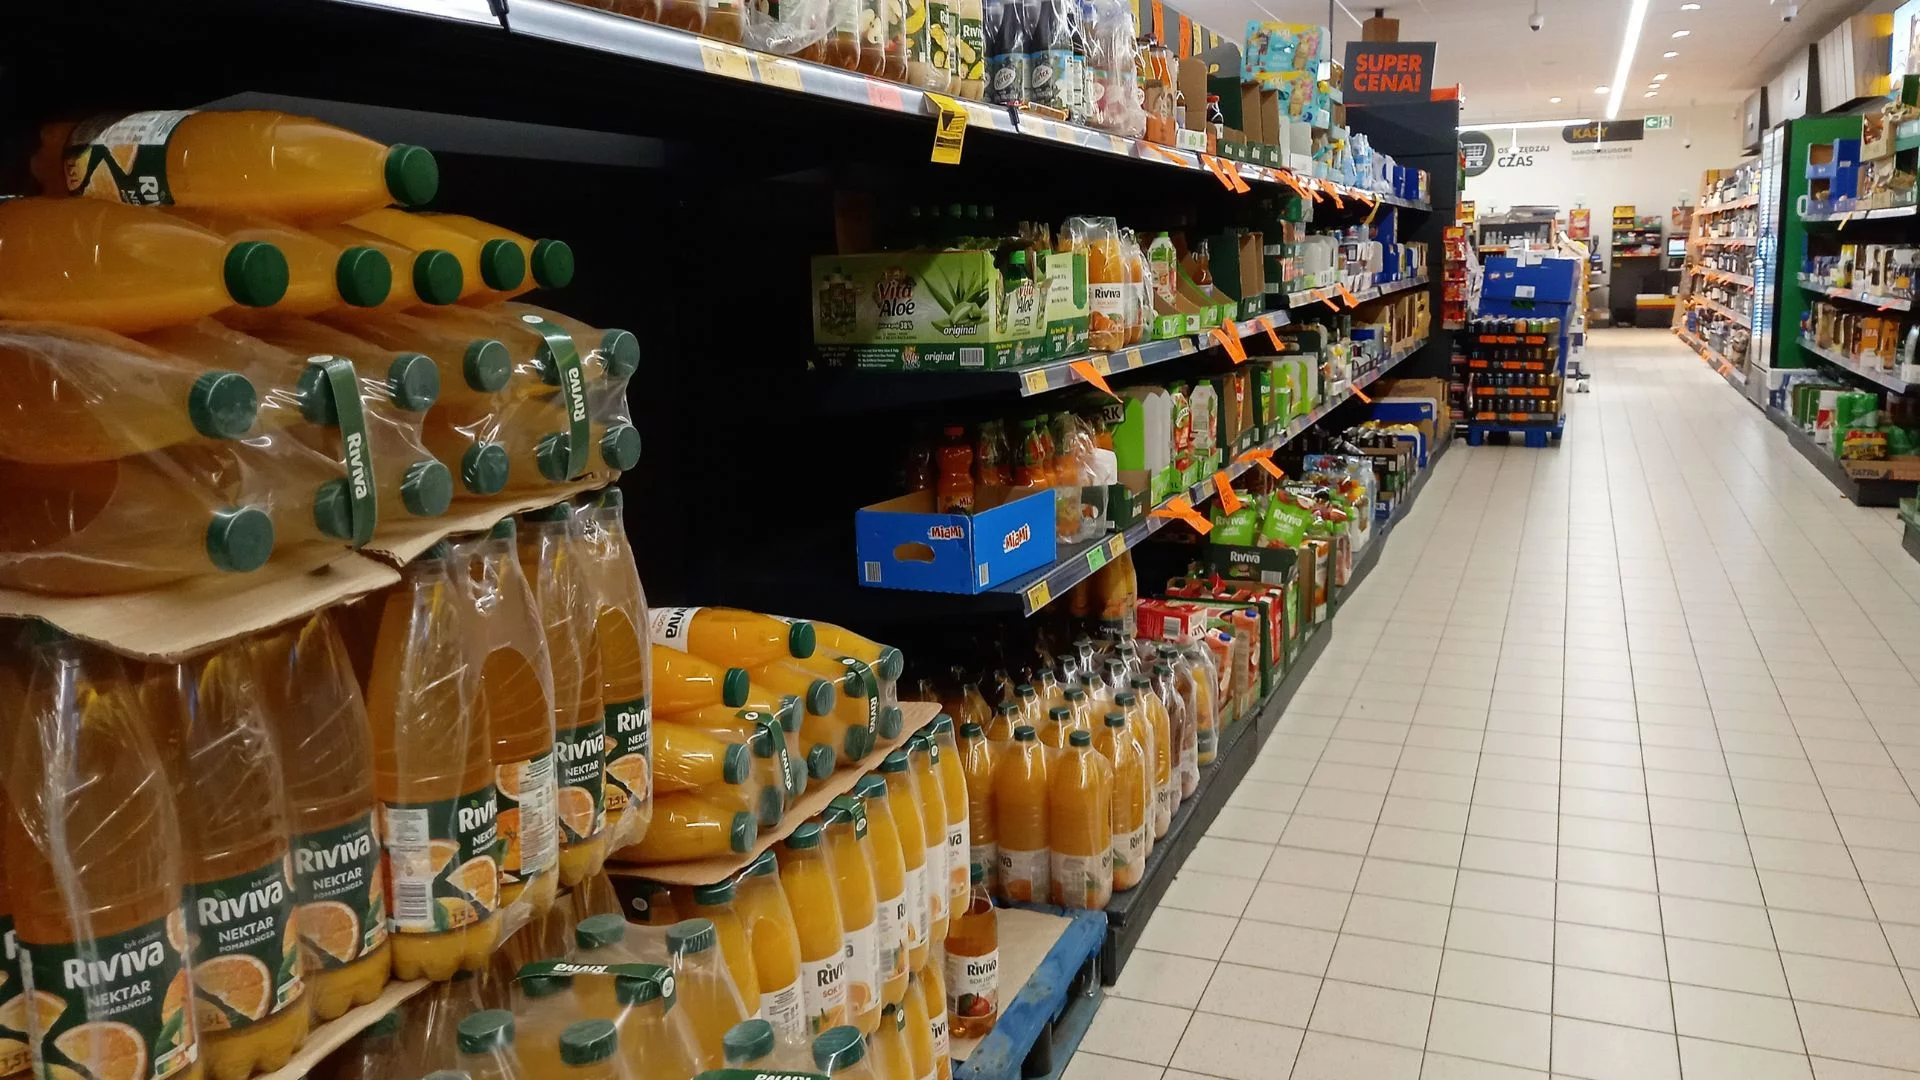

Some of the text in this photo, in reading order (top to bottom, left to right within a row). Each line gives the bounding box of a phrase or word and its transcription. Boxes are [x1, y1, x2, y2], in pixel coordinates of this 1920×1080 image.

[1355, 54, 1423, 72] SUPER
[1353, 73, 1422, 92] CENA!
[1572, 126, 1608, 139] KASY
[1497, 145, 1550, 155] OSZĘDZAJ
[878, 279, 913, 300] Vita
[1095, 287, 1121, 298] Riviva
[943, 324, 977, 338] original
[924, 352, 955, 364] original
[569, 367, 585, 423] Riviva
[347, 431, 367, 500] Riviva
[931, 526, 963, 539] MiaMi
[1230, 550, 1260, 564] Riviva
[617, 708, 650, 733] Rivi
[870, 696, 879, 734] Riviva
[554, 734, 604, 763] Riviva
[565, 760, 599, 777] NEKTAR
[459, 793, 498, 834] Rivi
[296, 834, 371, 875] Riviva
[312, 867, 363, 891] NEKTAR
[198, 880, 284, 926] Riviva
[218, 916, 275, 944] NEKTAR
[63, 941, 165, 990] Riviva
[817, 962, 847, 988] Rivi
[967, 959, 997, 976] Riviva
[88, 979, 152, 1009] NEKTAR
